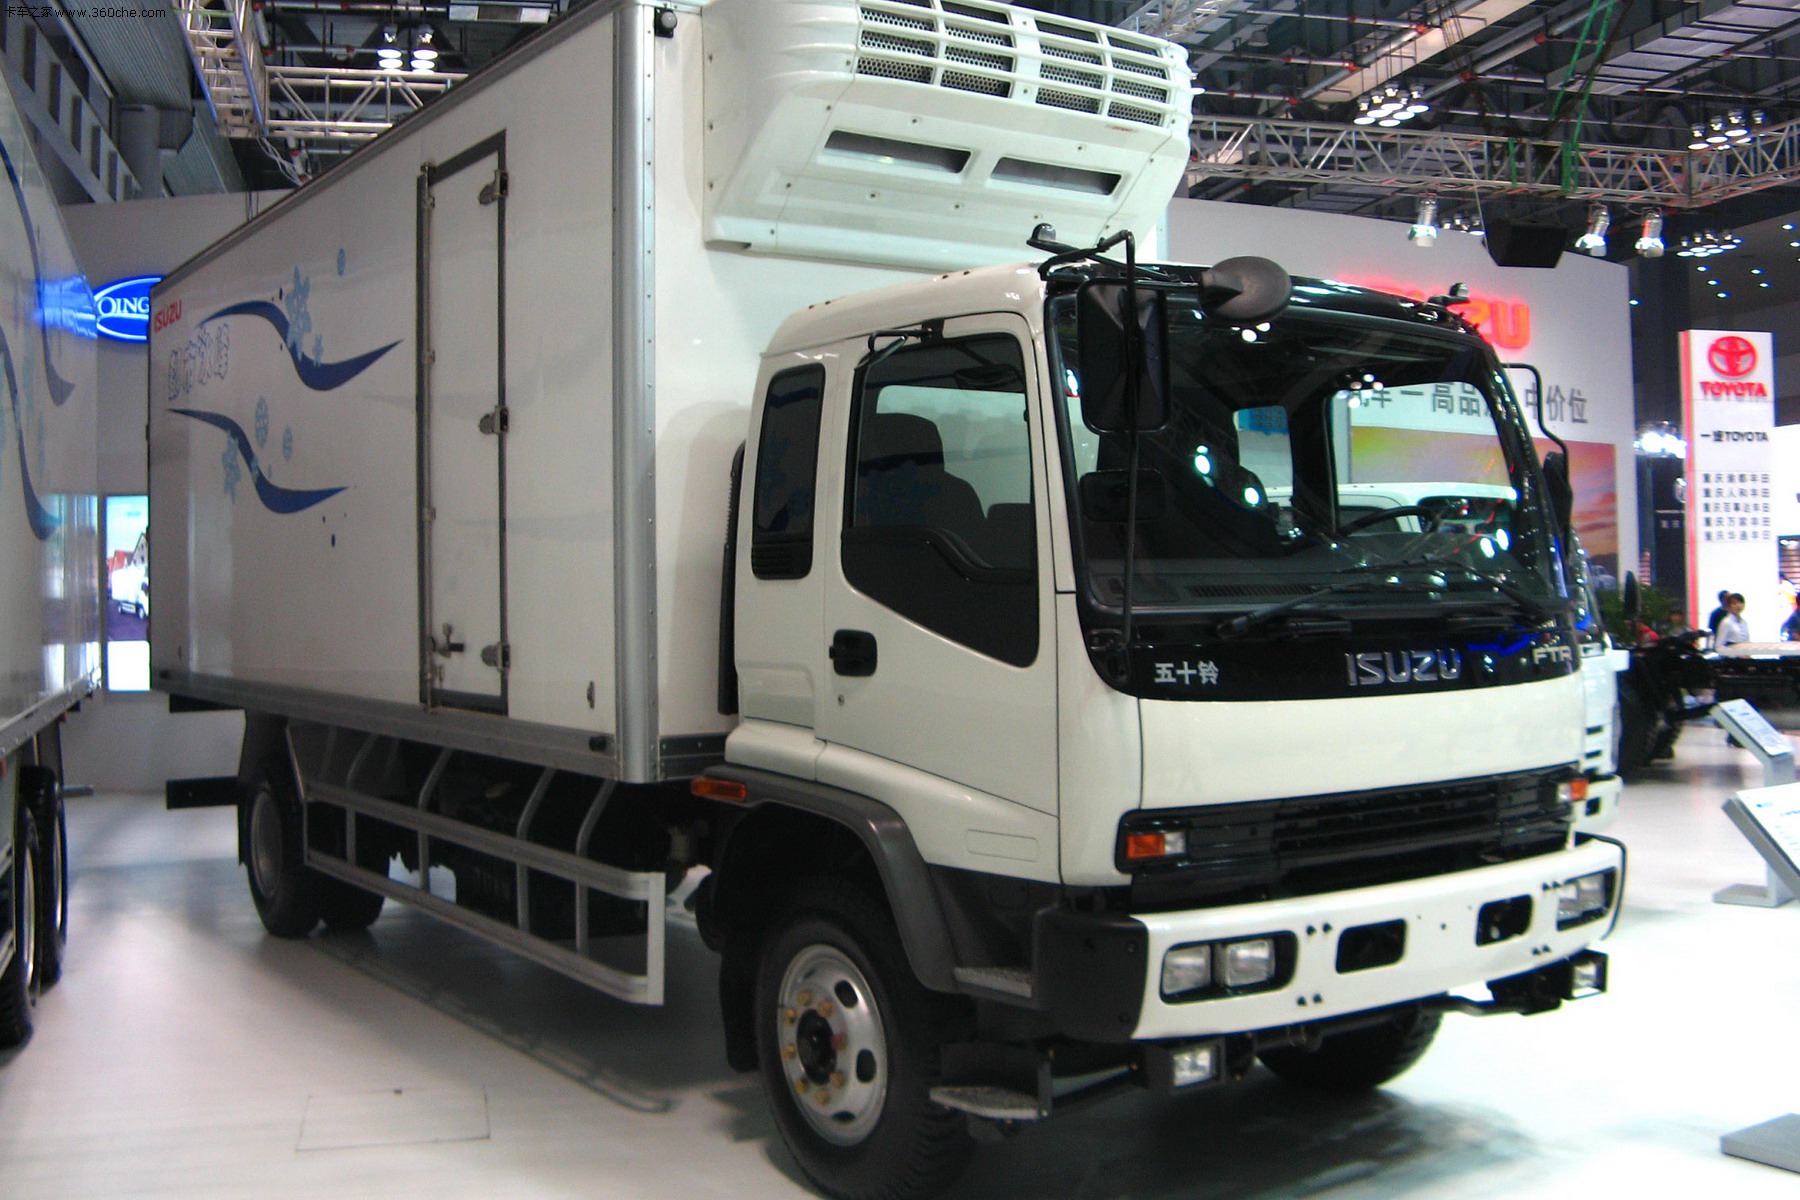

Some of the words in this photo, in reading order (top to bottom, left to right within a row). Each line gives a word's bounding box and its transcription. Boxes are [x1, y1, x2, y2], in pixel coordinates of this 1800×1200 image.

[154, 300, 182, 333] ISUZU
[1700, 381, 1768, 397] TOYOTA
[1345, 648, 1461, 686] ISUZU
[1532, 646, 1572, 665] FTR
[1154, 660, 1219, 685] 五十铃
